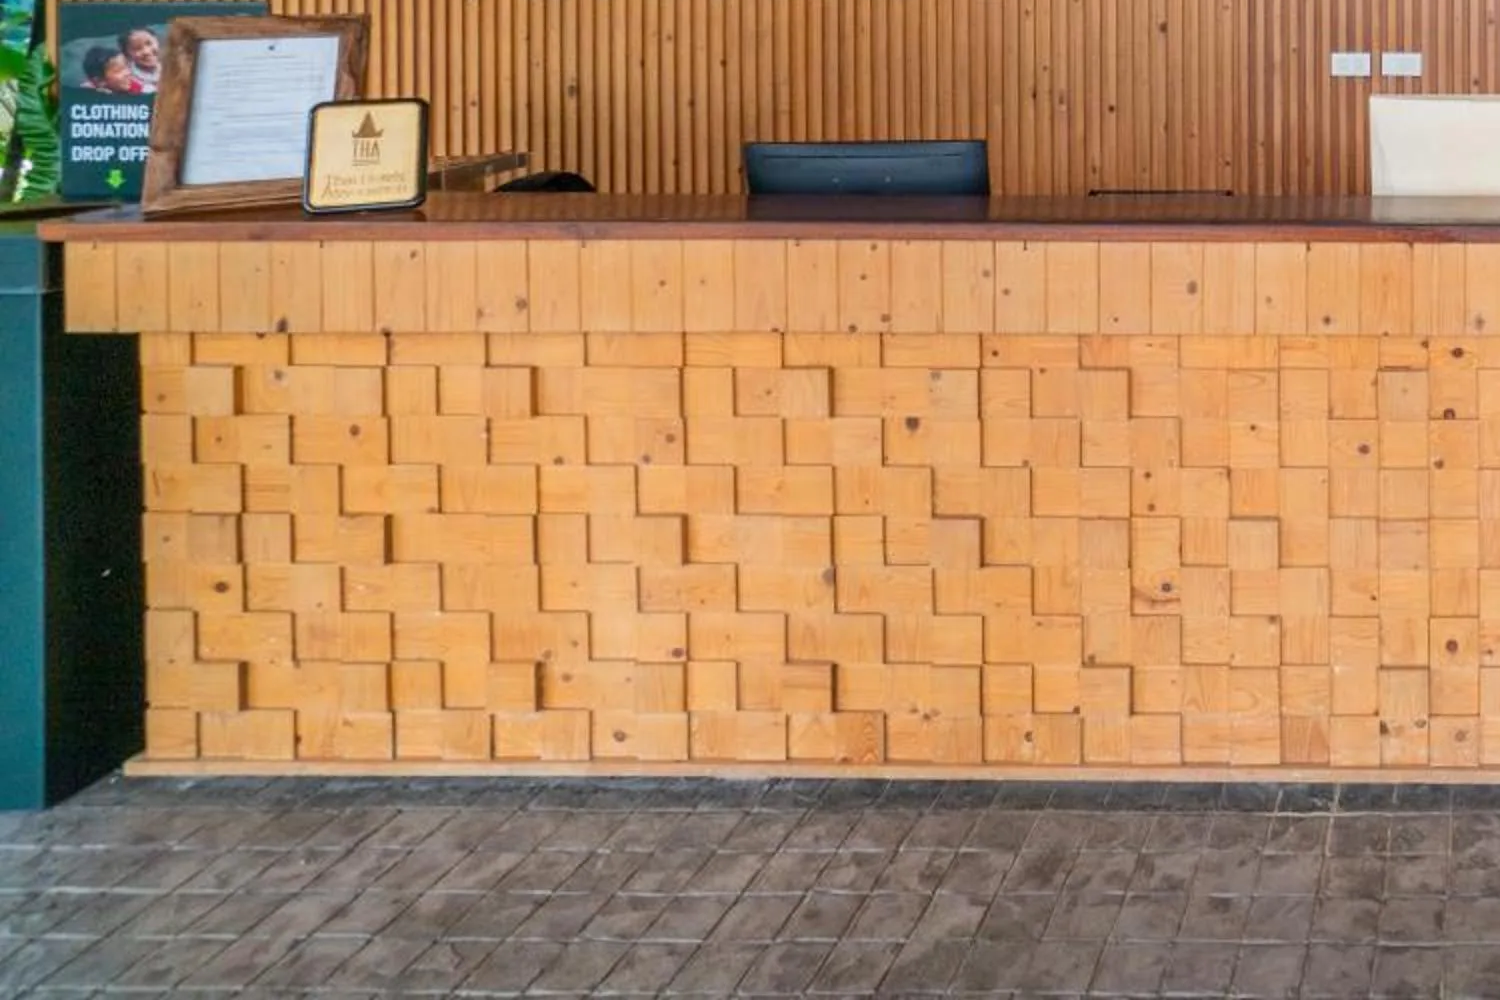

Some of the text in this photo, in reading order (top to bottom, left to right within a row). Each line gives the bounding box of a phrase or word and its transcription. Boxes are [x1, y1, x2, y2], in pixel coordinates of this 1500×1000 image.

[71, 104, 150, 120] CLOTHING
[71, 122, 149, 138] DONATION
[71, 145, 149, 161] DROP OFF
